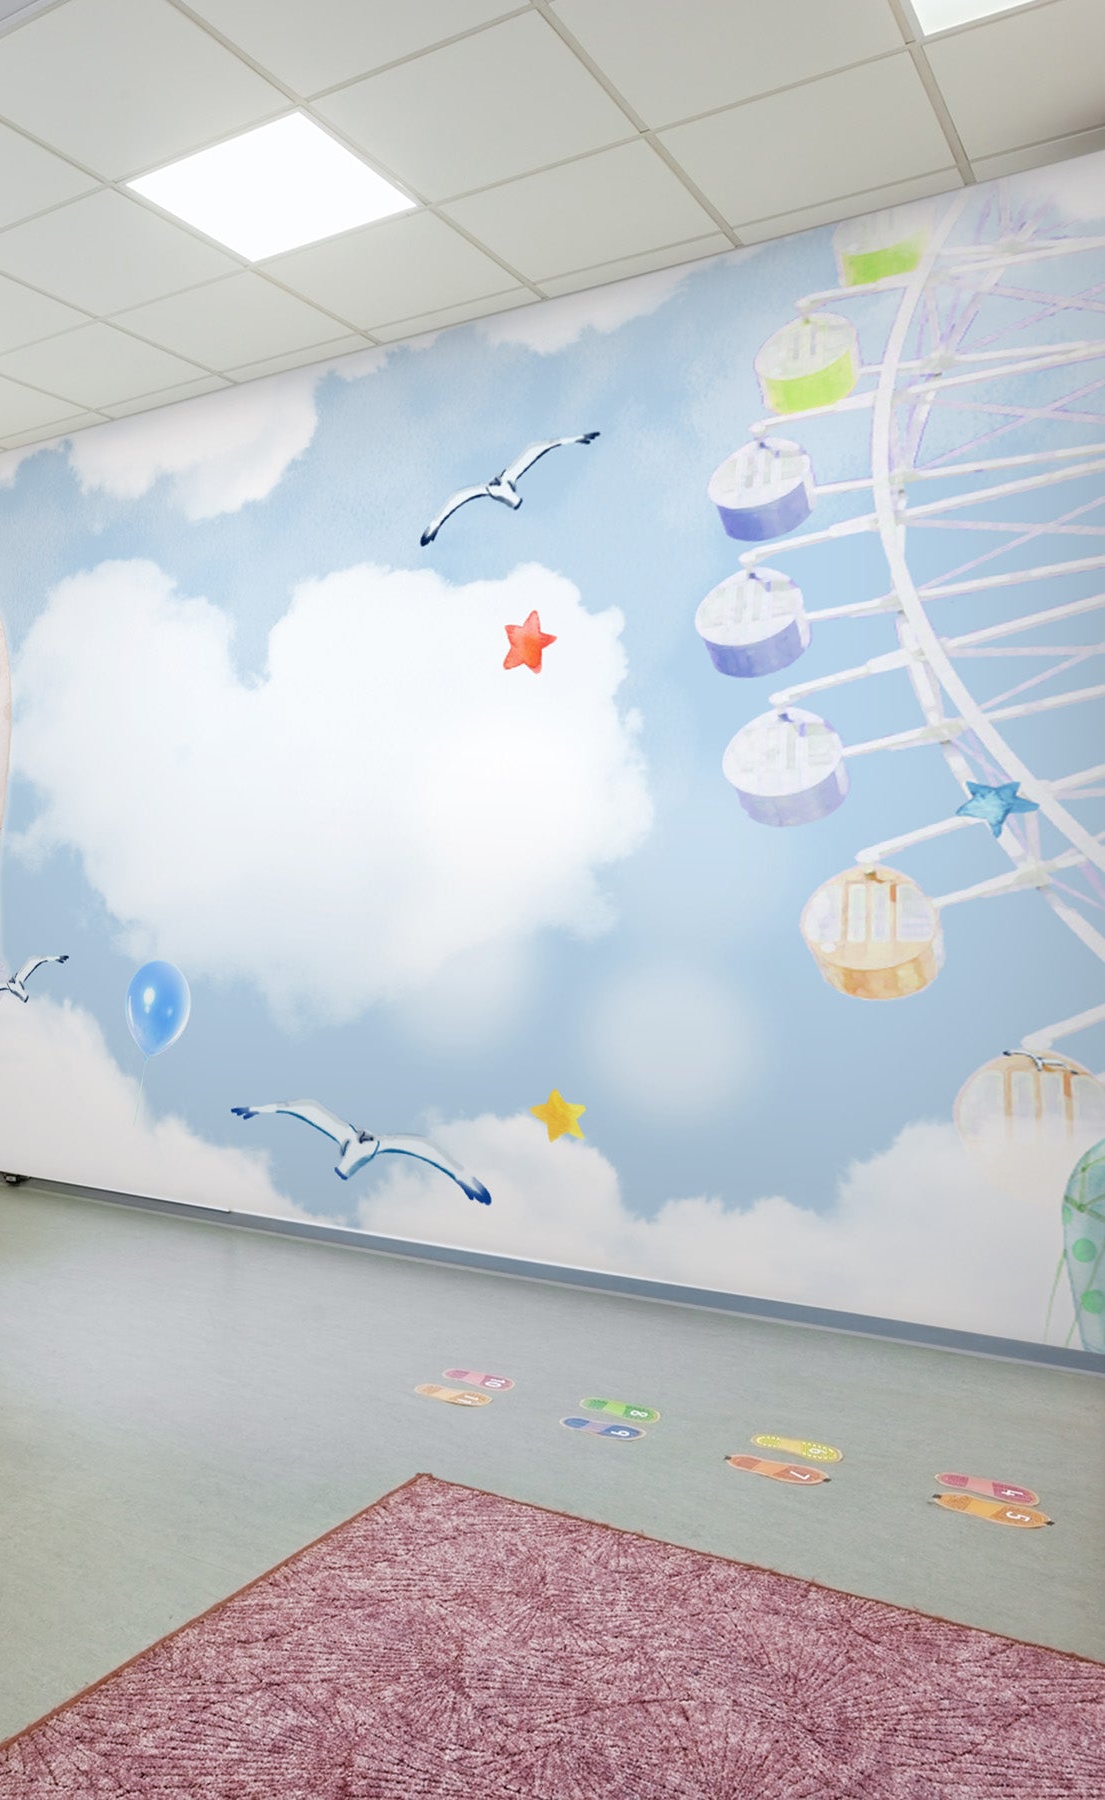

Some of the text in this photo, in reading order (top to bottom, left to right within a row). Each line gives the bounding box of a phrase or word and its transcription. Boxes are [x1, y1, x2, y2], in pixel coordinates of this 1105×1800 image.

[484, 1378, 506, 1388] 10
[629, 1409, 648, 1418] 8
[809, 1447, 828, 1455] 6
[789, 1470, 811, 1481] 7
[1000, 1489, 1025, 1497] 4
[1005, 1511, 1031, 1522] 5
